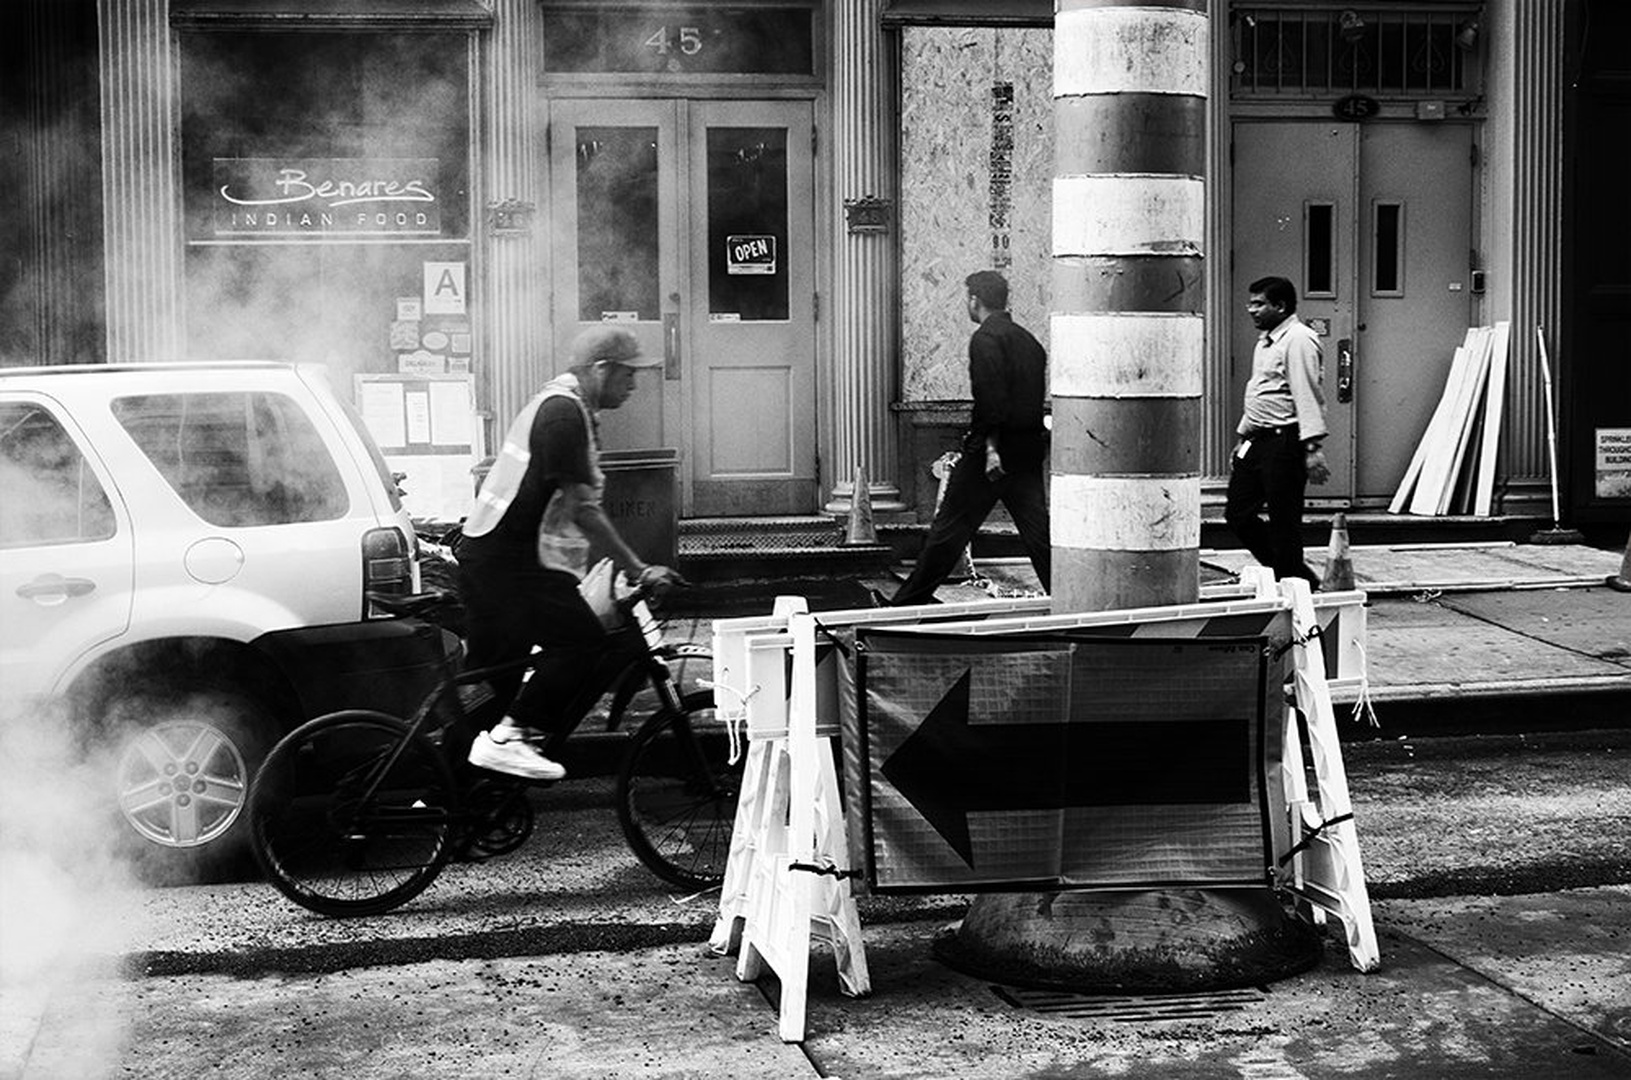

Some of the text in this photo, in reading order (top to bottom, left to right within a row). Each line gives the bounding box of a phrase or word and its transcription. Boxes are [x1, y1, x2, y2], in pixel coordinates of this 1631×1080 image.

[645, 26, 702, 55] 45
[1343, 99, 1369, 117] 45
[221, 169, 435, 206] Benares
[232, 213, 427, 226] INDIAN FOOD
[734, 238, 768, 262] OPEN
[434, 268, 459, 296] A
